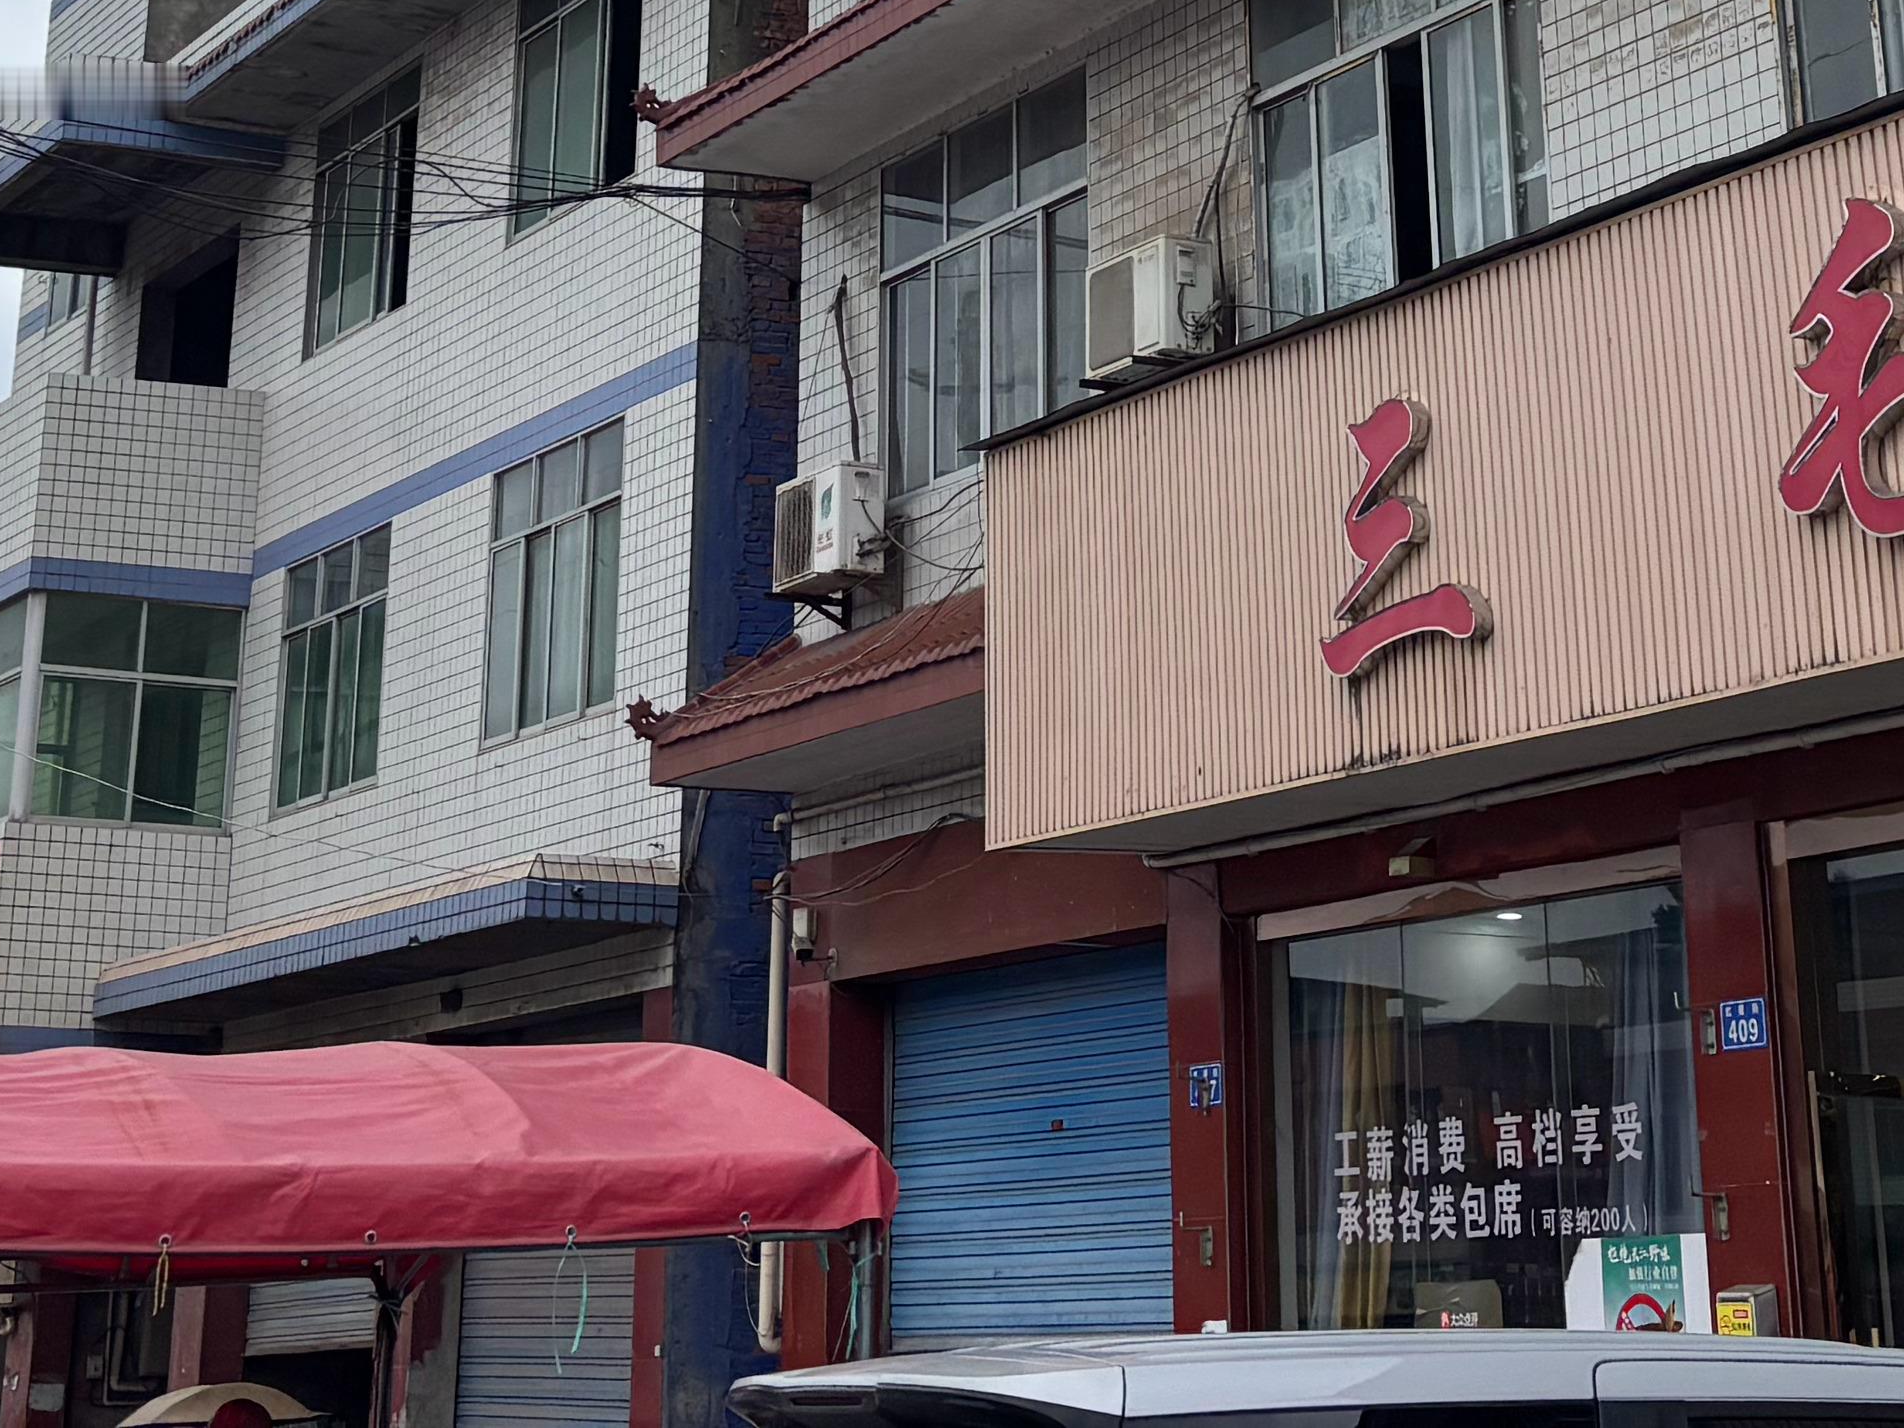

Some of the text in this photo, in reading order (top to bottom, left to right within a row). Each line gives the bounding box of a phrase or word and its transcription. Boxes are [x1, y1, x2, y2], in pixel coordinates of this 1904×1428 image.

[1728, 1018, 1758, 1042] 409
[1334, 1102, 1643, 1181] 工薪消费 高档享受
[1337, 1179, 1522, 1244] 承接各类包席
